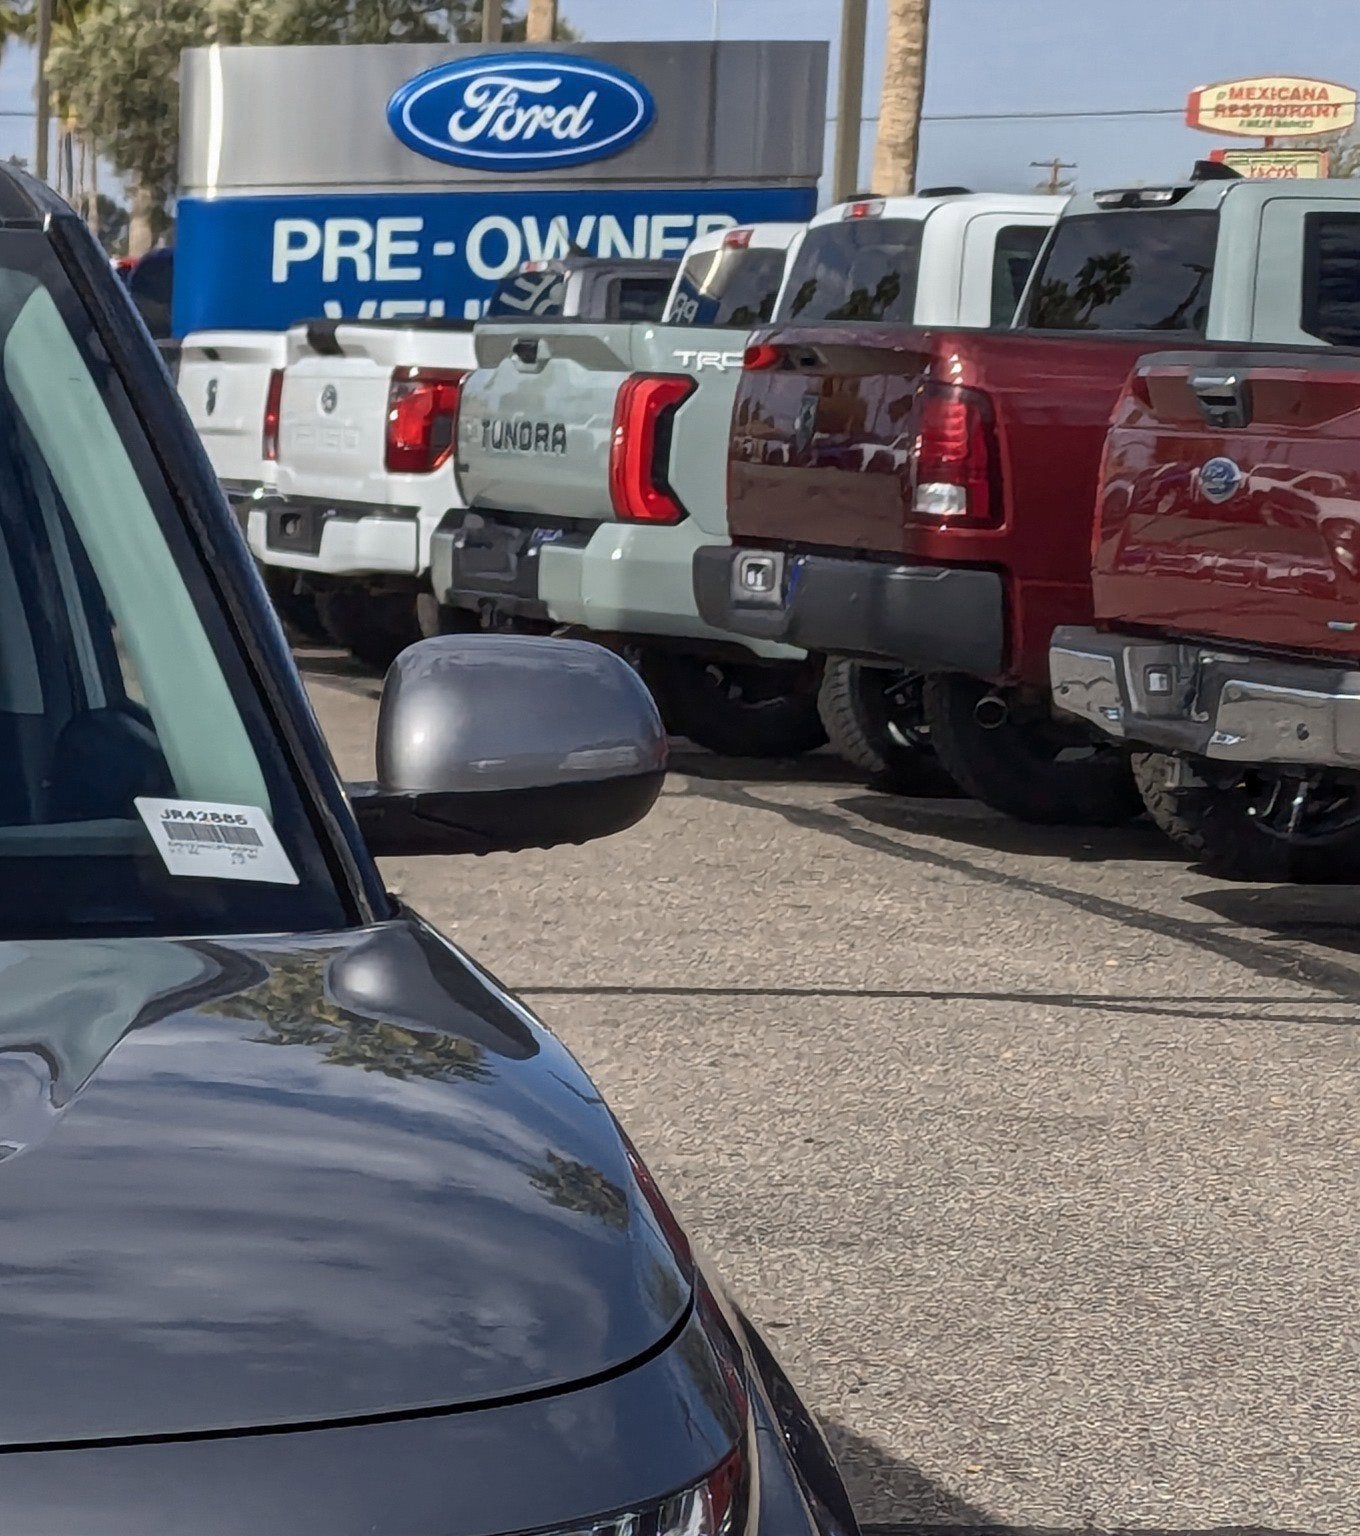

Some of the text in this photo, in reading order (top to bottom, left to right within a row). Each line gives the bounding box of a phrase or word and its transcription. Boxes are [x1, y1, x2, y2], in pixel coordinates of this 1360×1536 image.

[448, 76, 594, 143] Ford
[1214, 103, 1342, 118] RESTAURANT
[1229, 87, 1330, 101] MEXICANA
[271, 214, 738, 283] PRE-OWNE
[481, 419, 567, 454] TUNDRA
